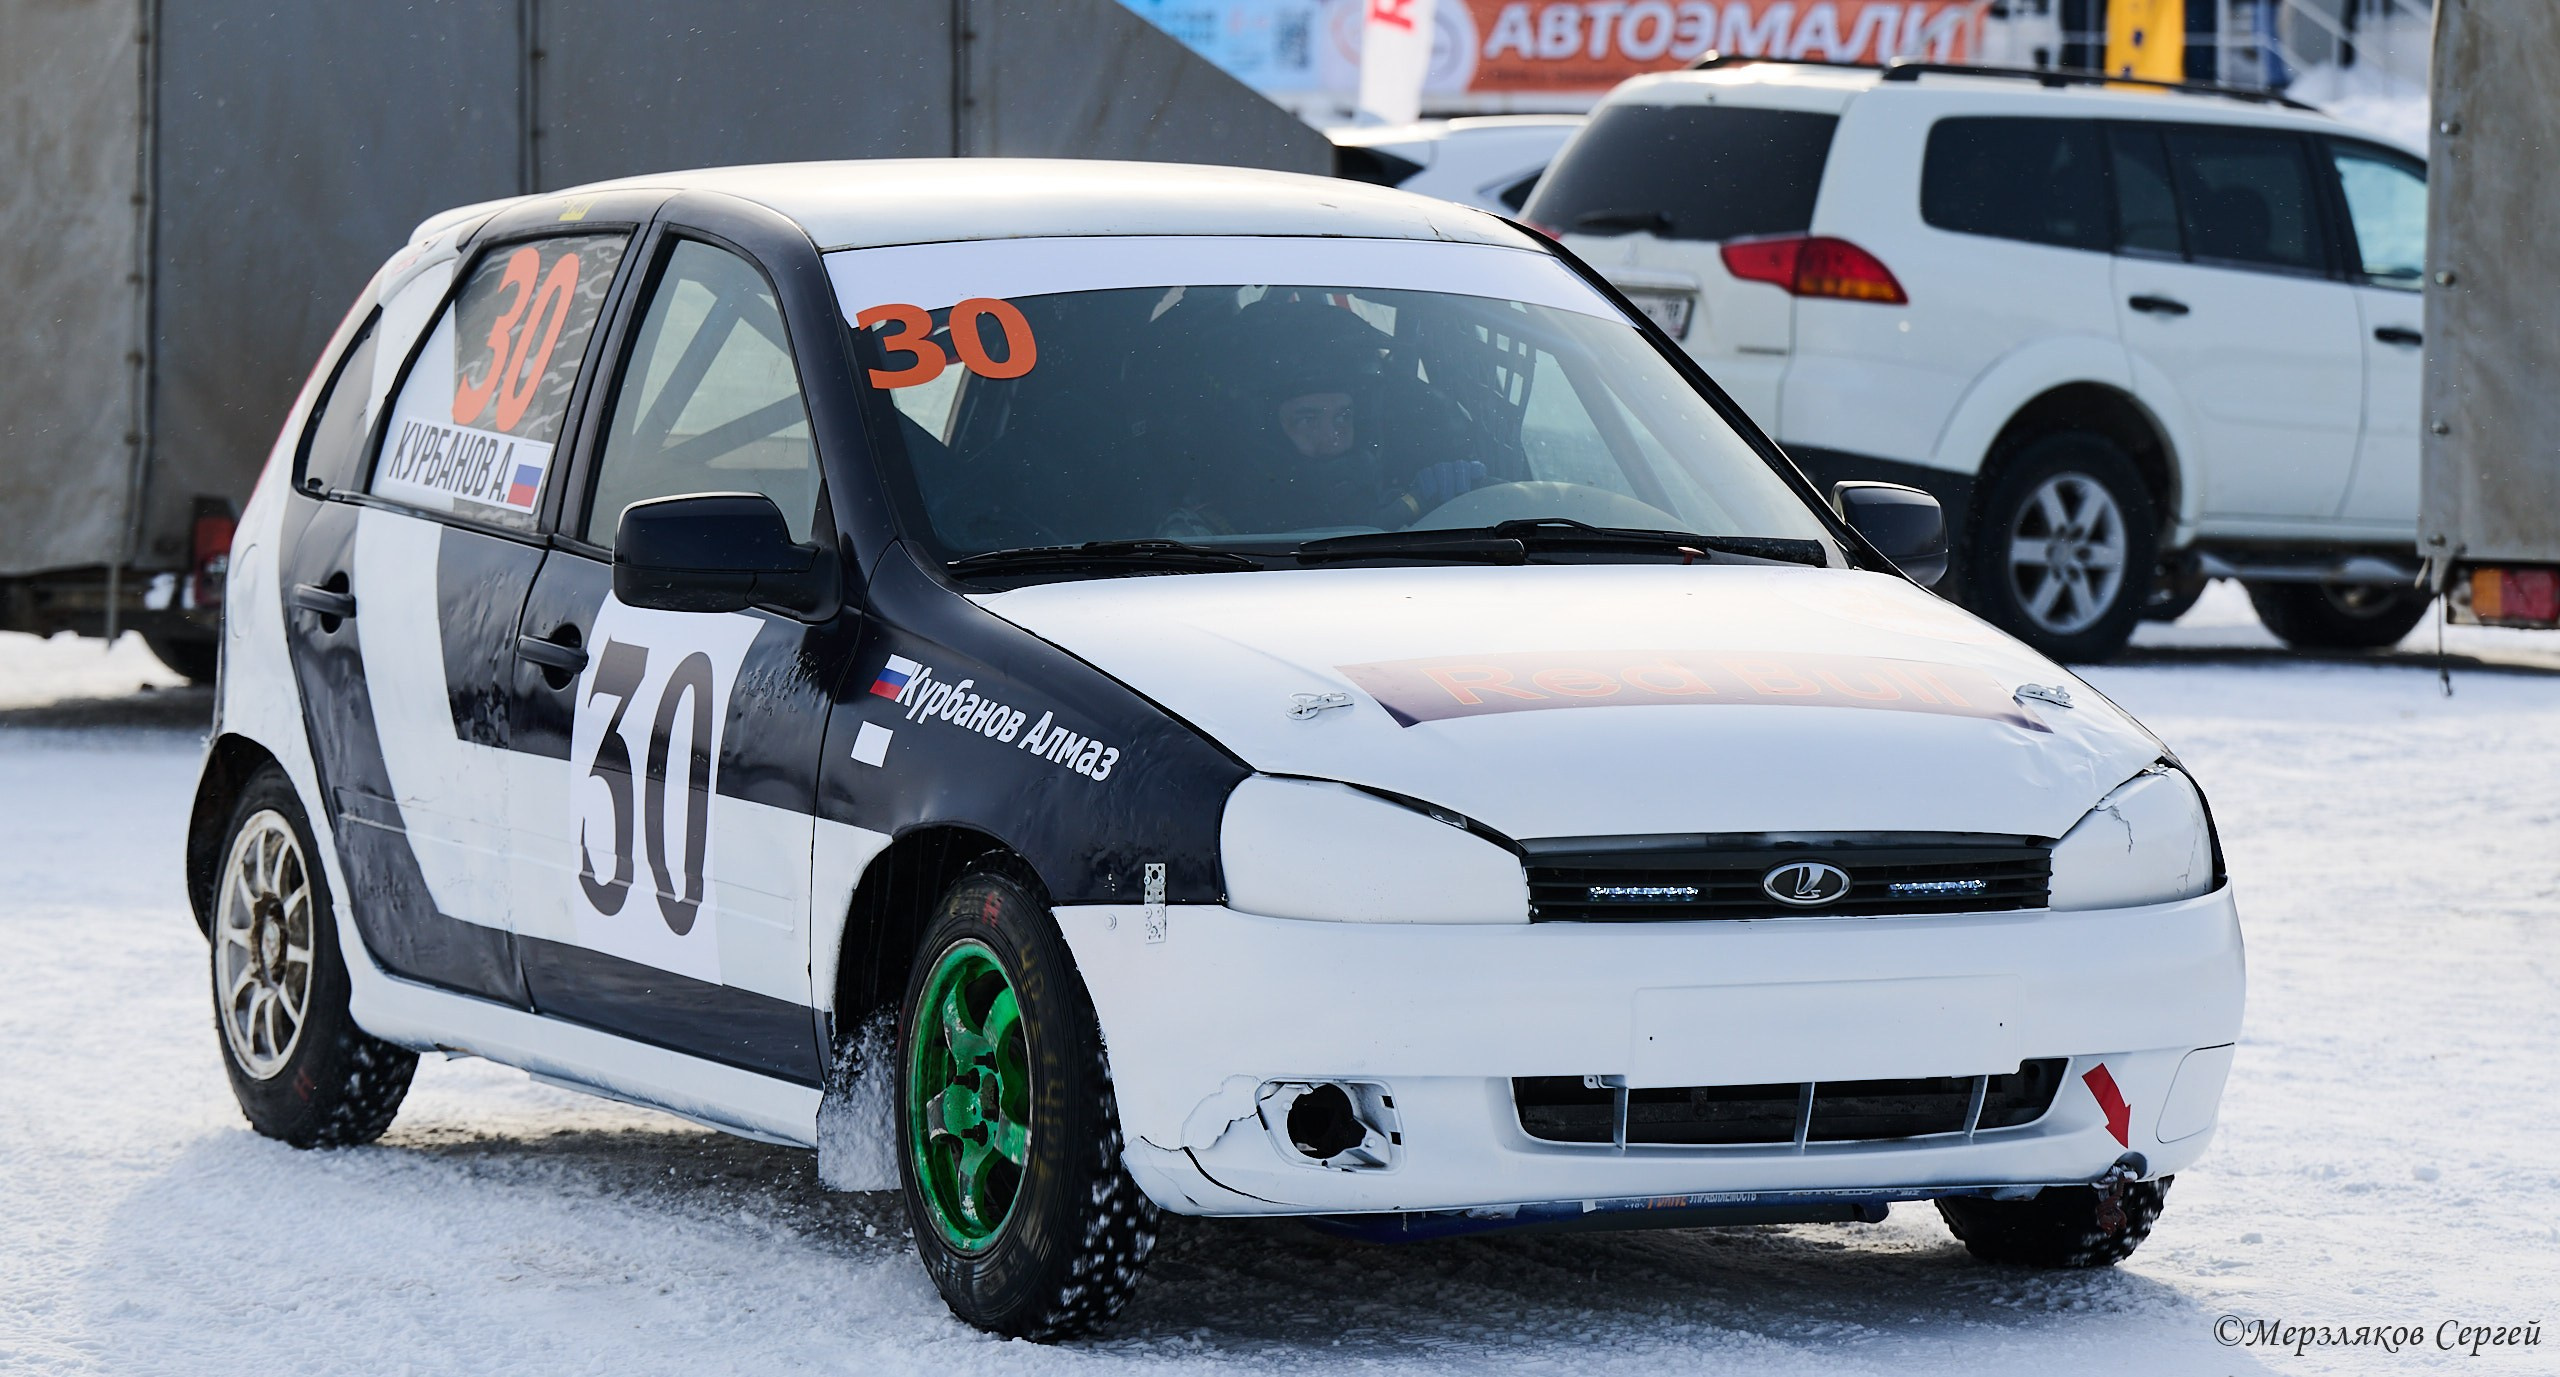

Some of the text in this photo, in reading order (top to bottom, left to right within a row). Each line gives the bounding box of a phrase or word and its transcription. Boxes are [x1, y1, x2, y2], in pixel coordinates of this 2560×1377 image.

[1484, 1, 1966, 64] АВТОЭМАЛИ
[452, 247, 580, 432] 30
[856, 297, 1037, 389] 30
[388, 420, 499, 497] КУРБАНОВ
[894, 663, 1120, 782] Курбанов Алмаз
[1418, 656, 1972, 707] Red Bull
[578, 633, 713, 936] 30
